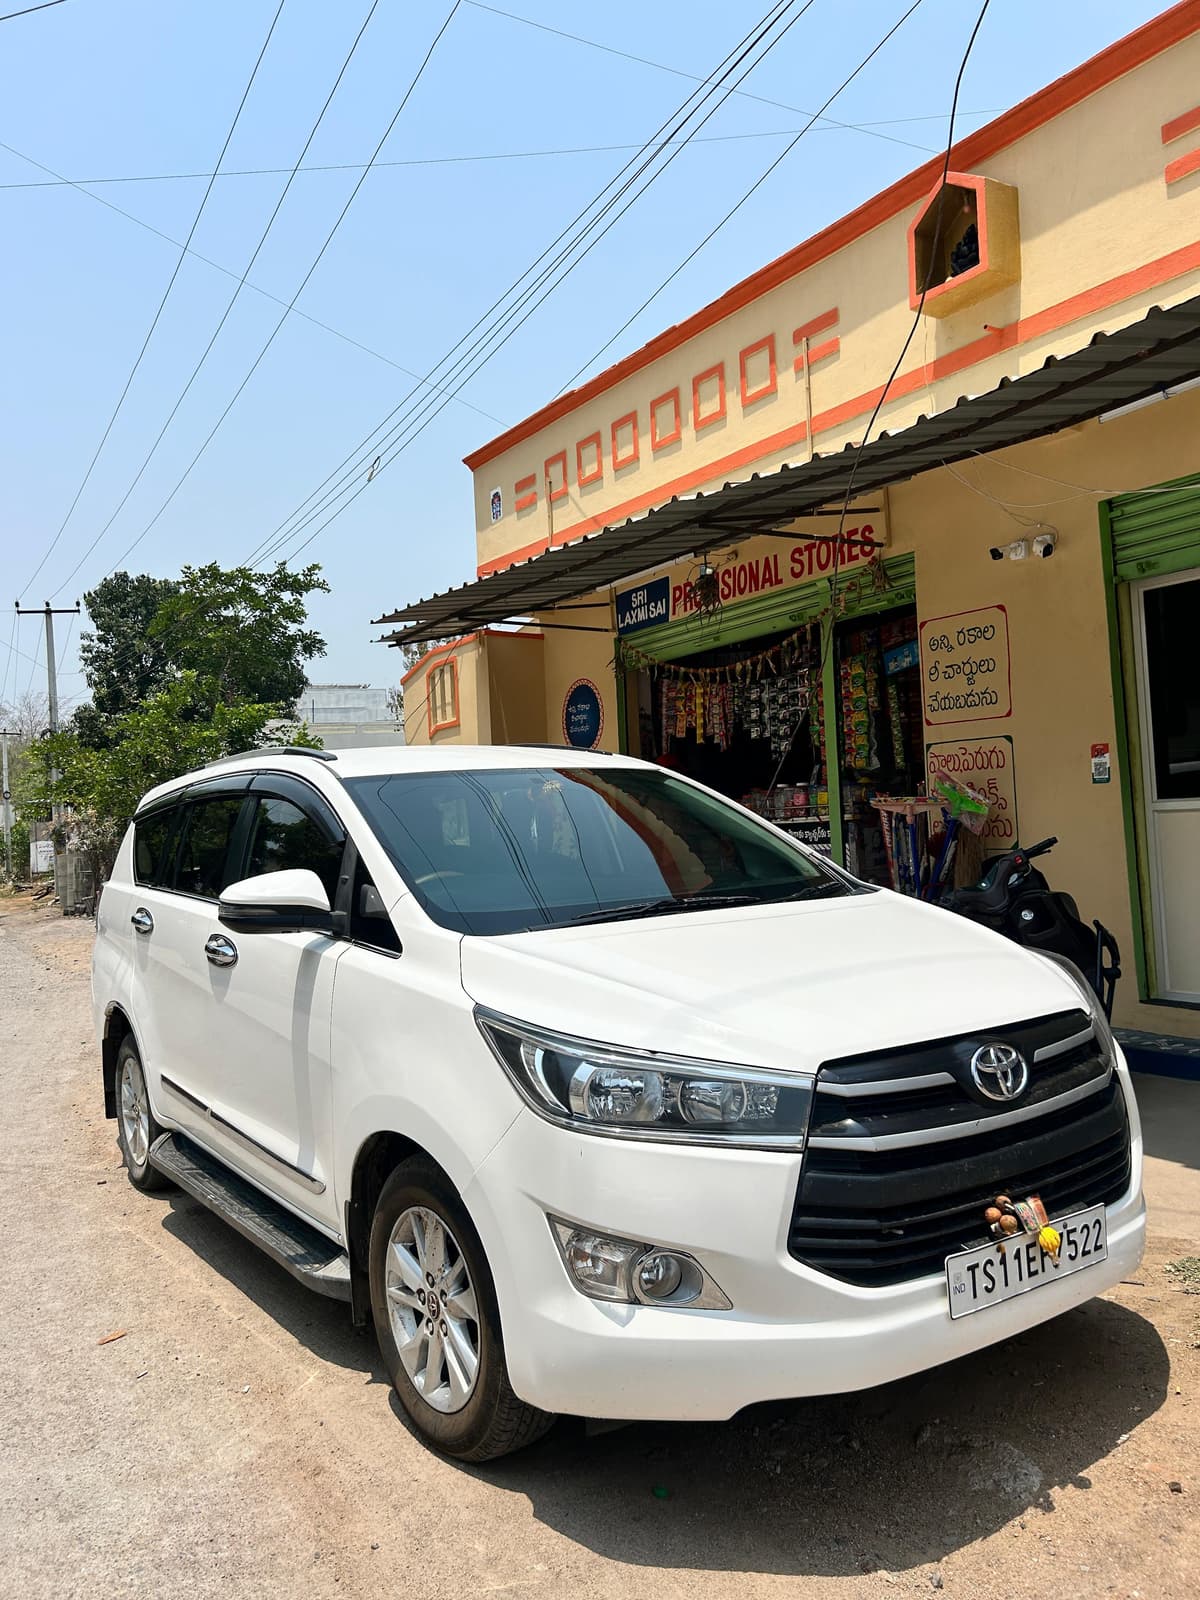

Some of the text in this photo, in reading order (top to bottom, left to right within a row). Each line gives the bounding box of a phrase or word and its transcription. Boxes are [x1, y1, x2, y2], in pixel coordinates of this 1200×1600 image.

[790, 524, 875, 578] STORES
[631, 589, 648, 608] SRI
[618, 598, 666, 628] LAXMI SAI
[929, 624, 996, 653] అన్ని రకాల
[927, 687, 998, 713] చేయబడును
[952, 1283, 966, 1296] IND
